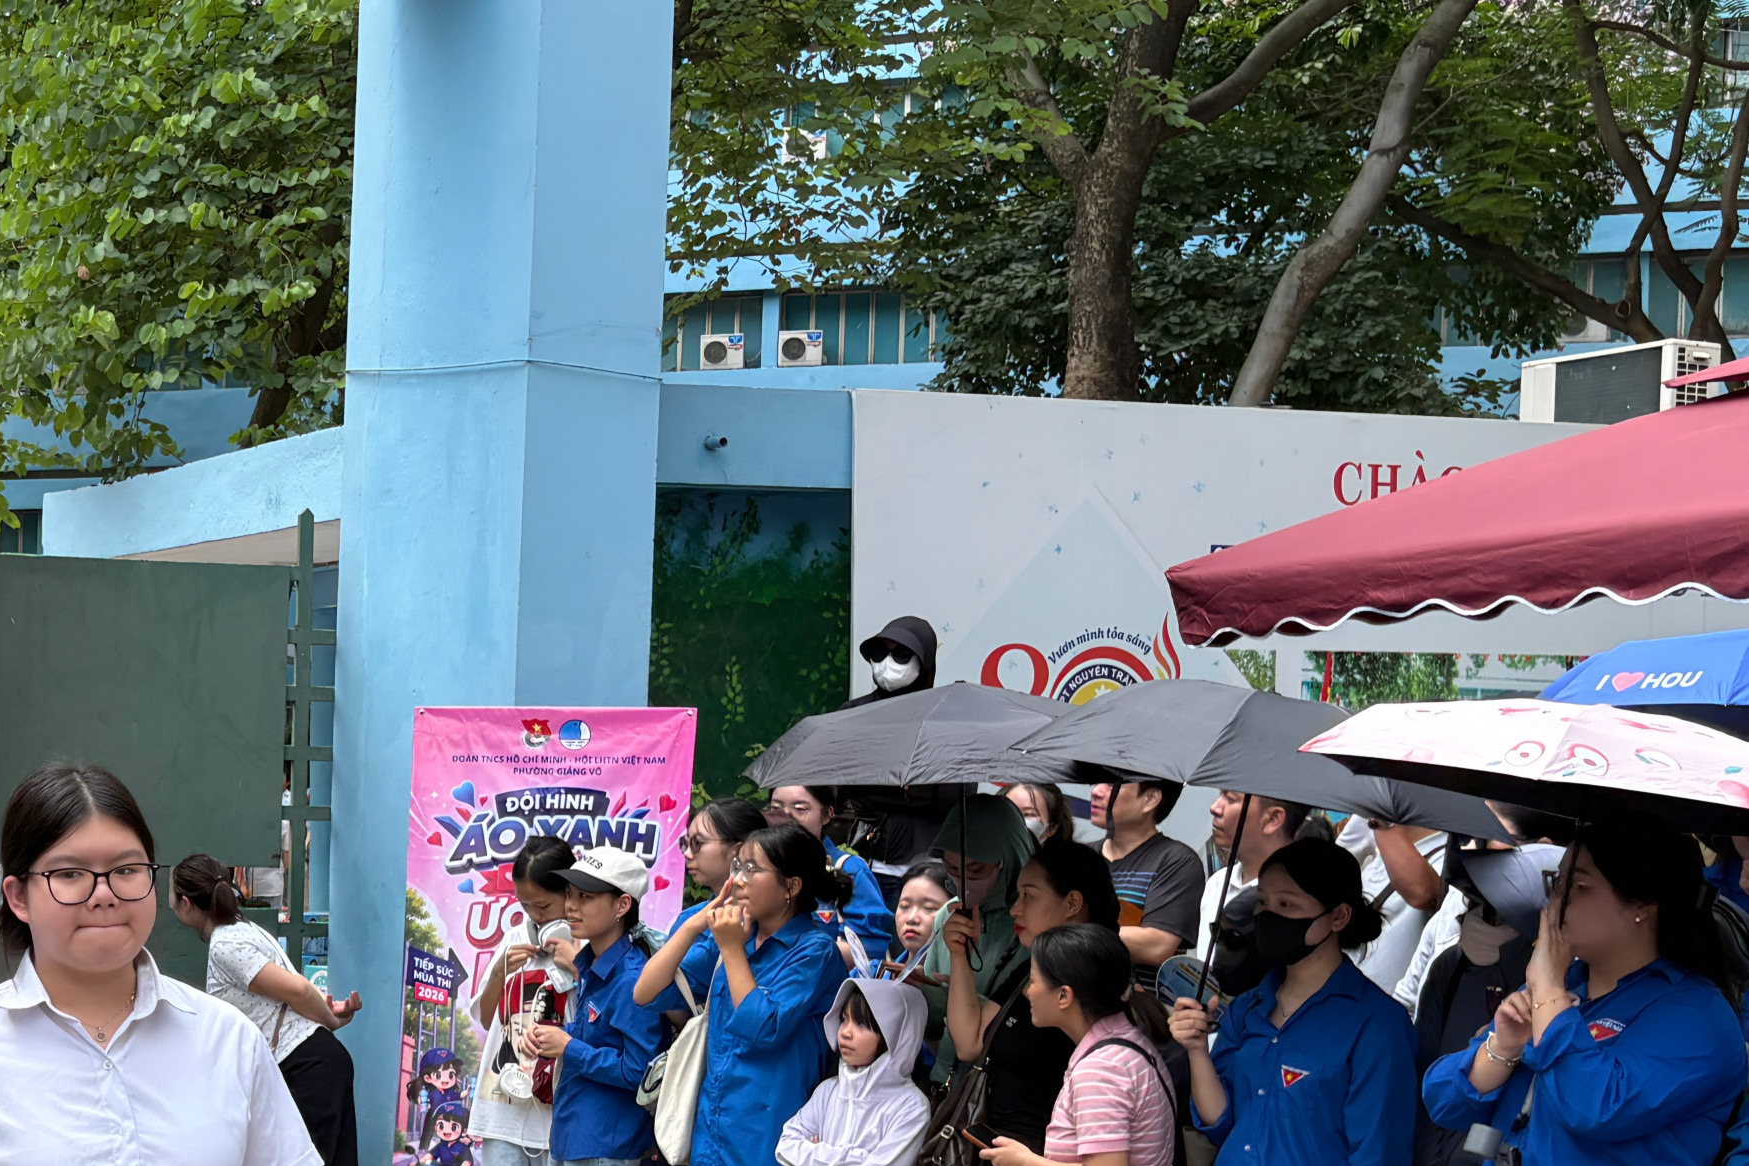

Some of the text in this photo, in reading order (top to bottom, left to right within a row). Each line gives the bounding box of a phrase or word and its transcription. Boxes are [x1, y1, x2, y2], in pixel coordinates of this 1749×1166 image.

[1333, 450, 1464, 505] CHÀ
[1076, 627, 1104, 645] mình
[1126, 633, 1151, 655] sáng
[1595, 670, 1704, 691] I HOU
[540, 755, 567, 764] MINH
[643, 756, 666, 764] NAM
[505, 791, 595, 816] ĐỘI HÌNH
[446, 811, 529, 868] ÁO
[413, 956, 454, 978] TIẾP SỨC
[413, 970, 452, 989] MÙA THI
[418, 986, 445, 1002] 2026
